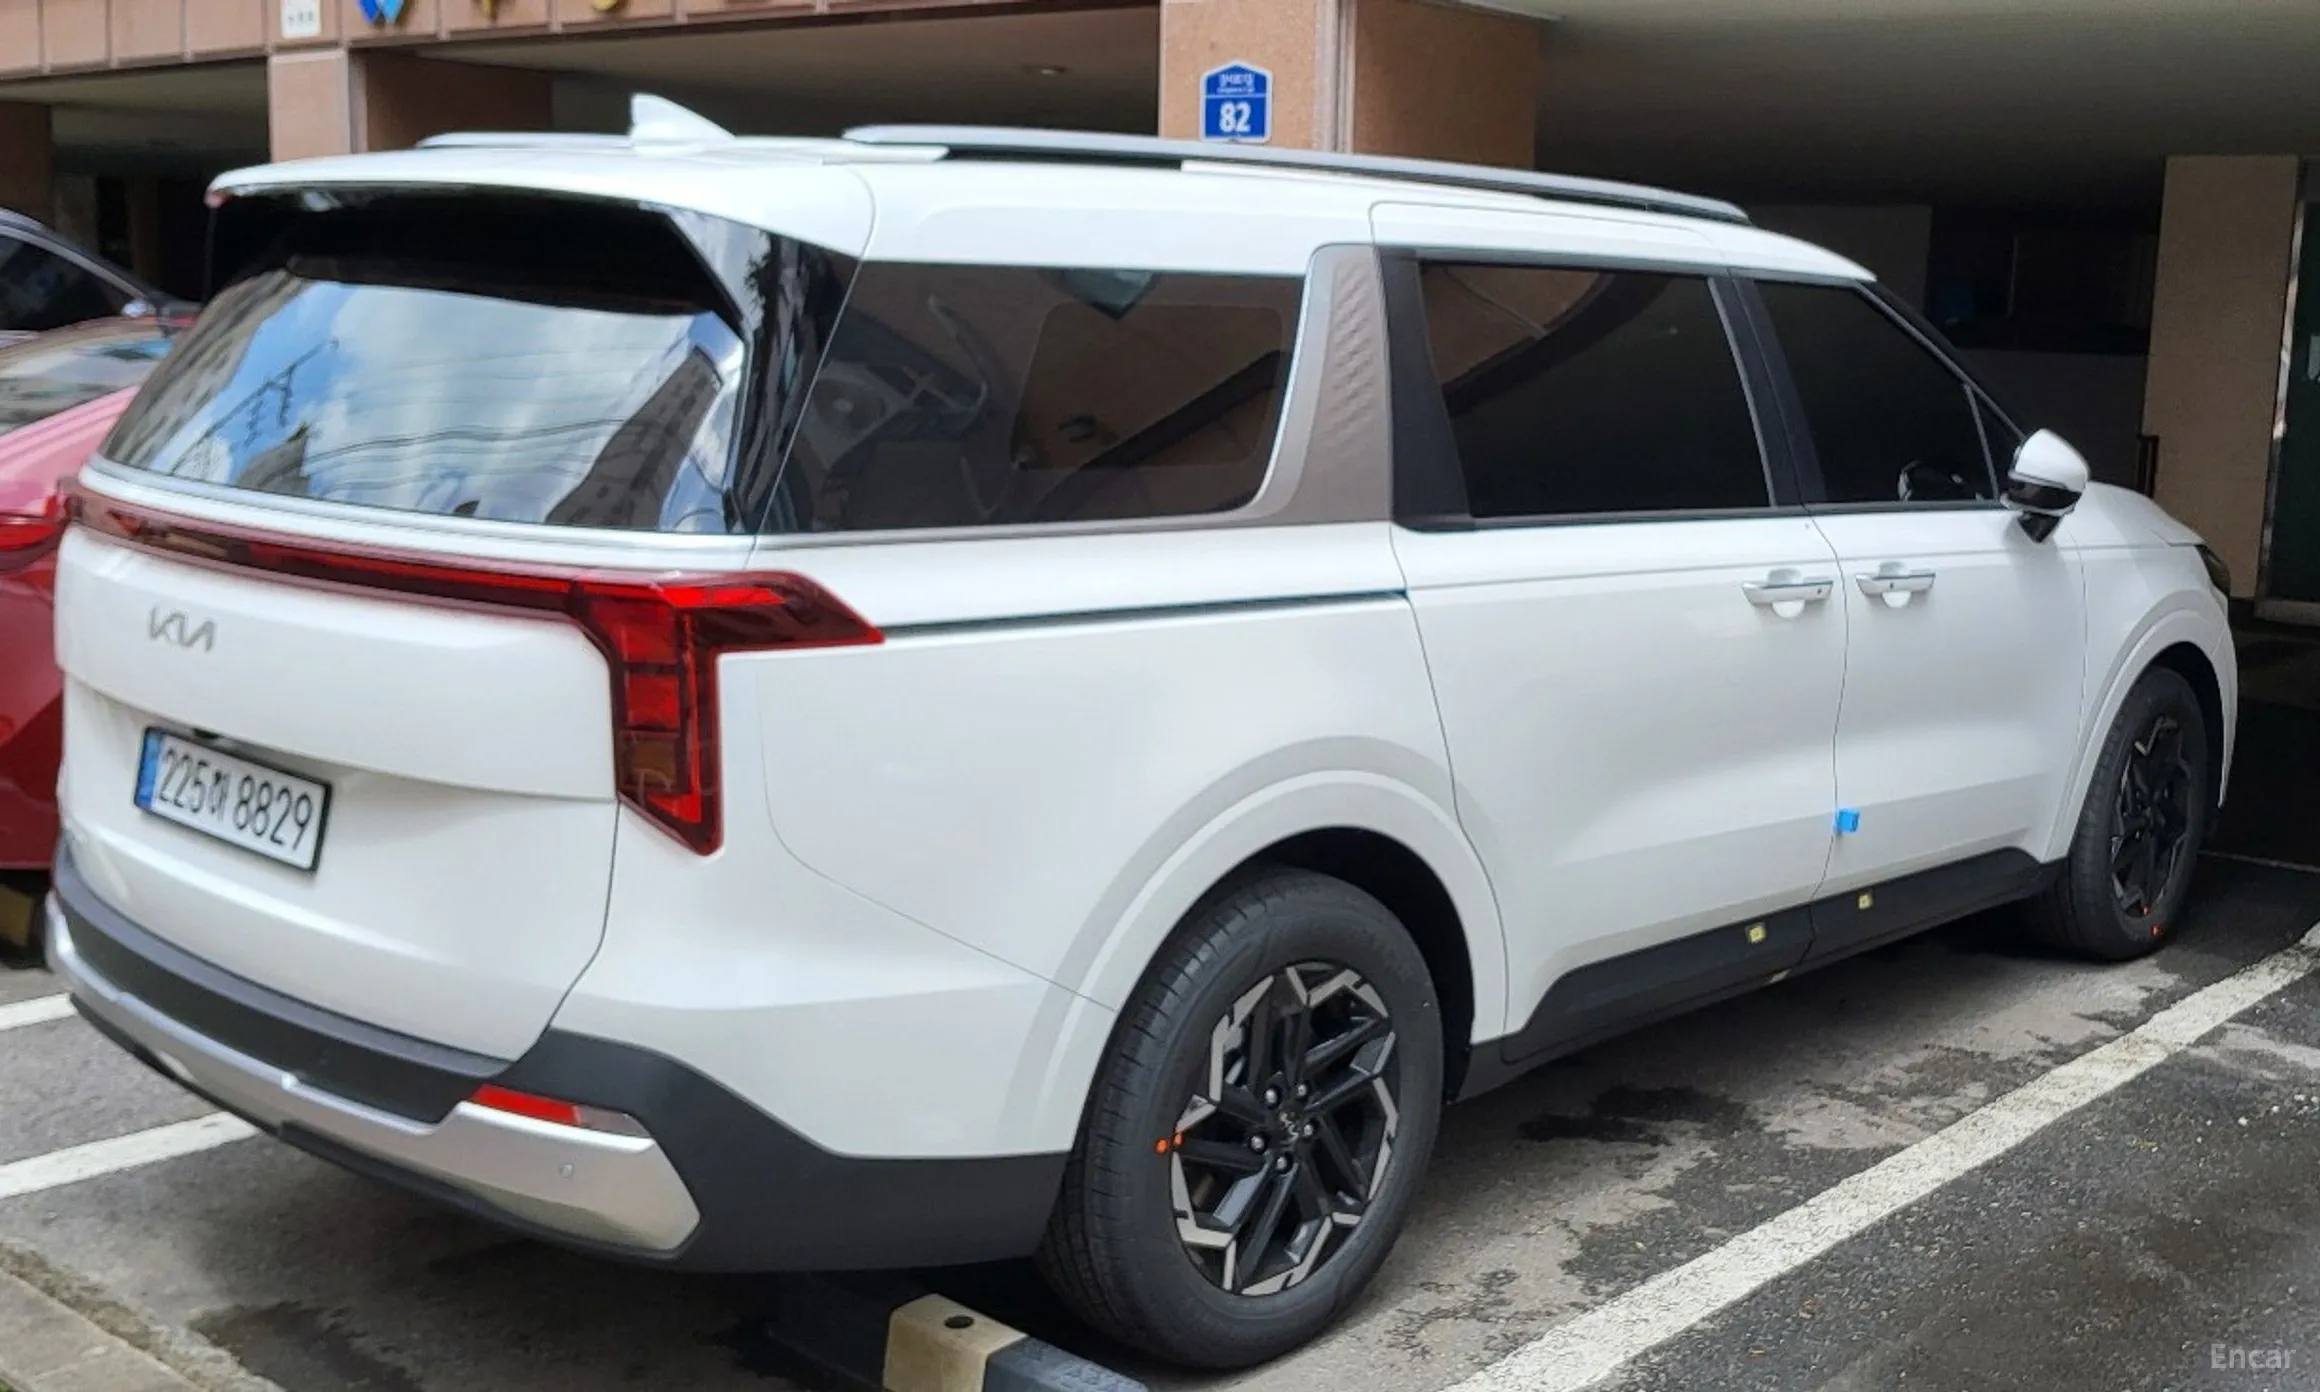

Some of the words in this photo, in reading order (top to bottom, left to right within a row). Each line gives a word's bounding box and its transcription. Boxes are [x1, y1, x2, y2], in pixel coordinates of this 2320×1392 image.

[1219, 102, 1252, 132] 82
[148, 605, 218, 653] KIA
[233, 775, 313, 850] 8829
